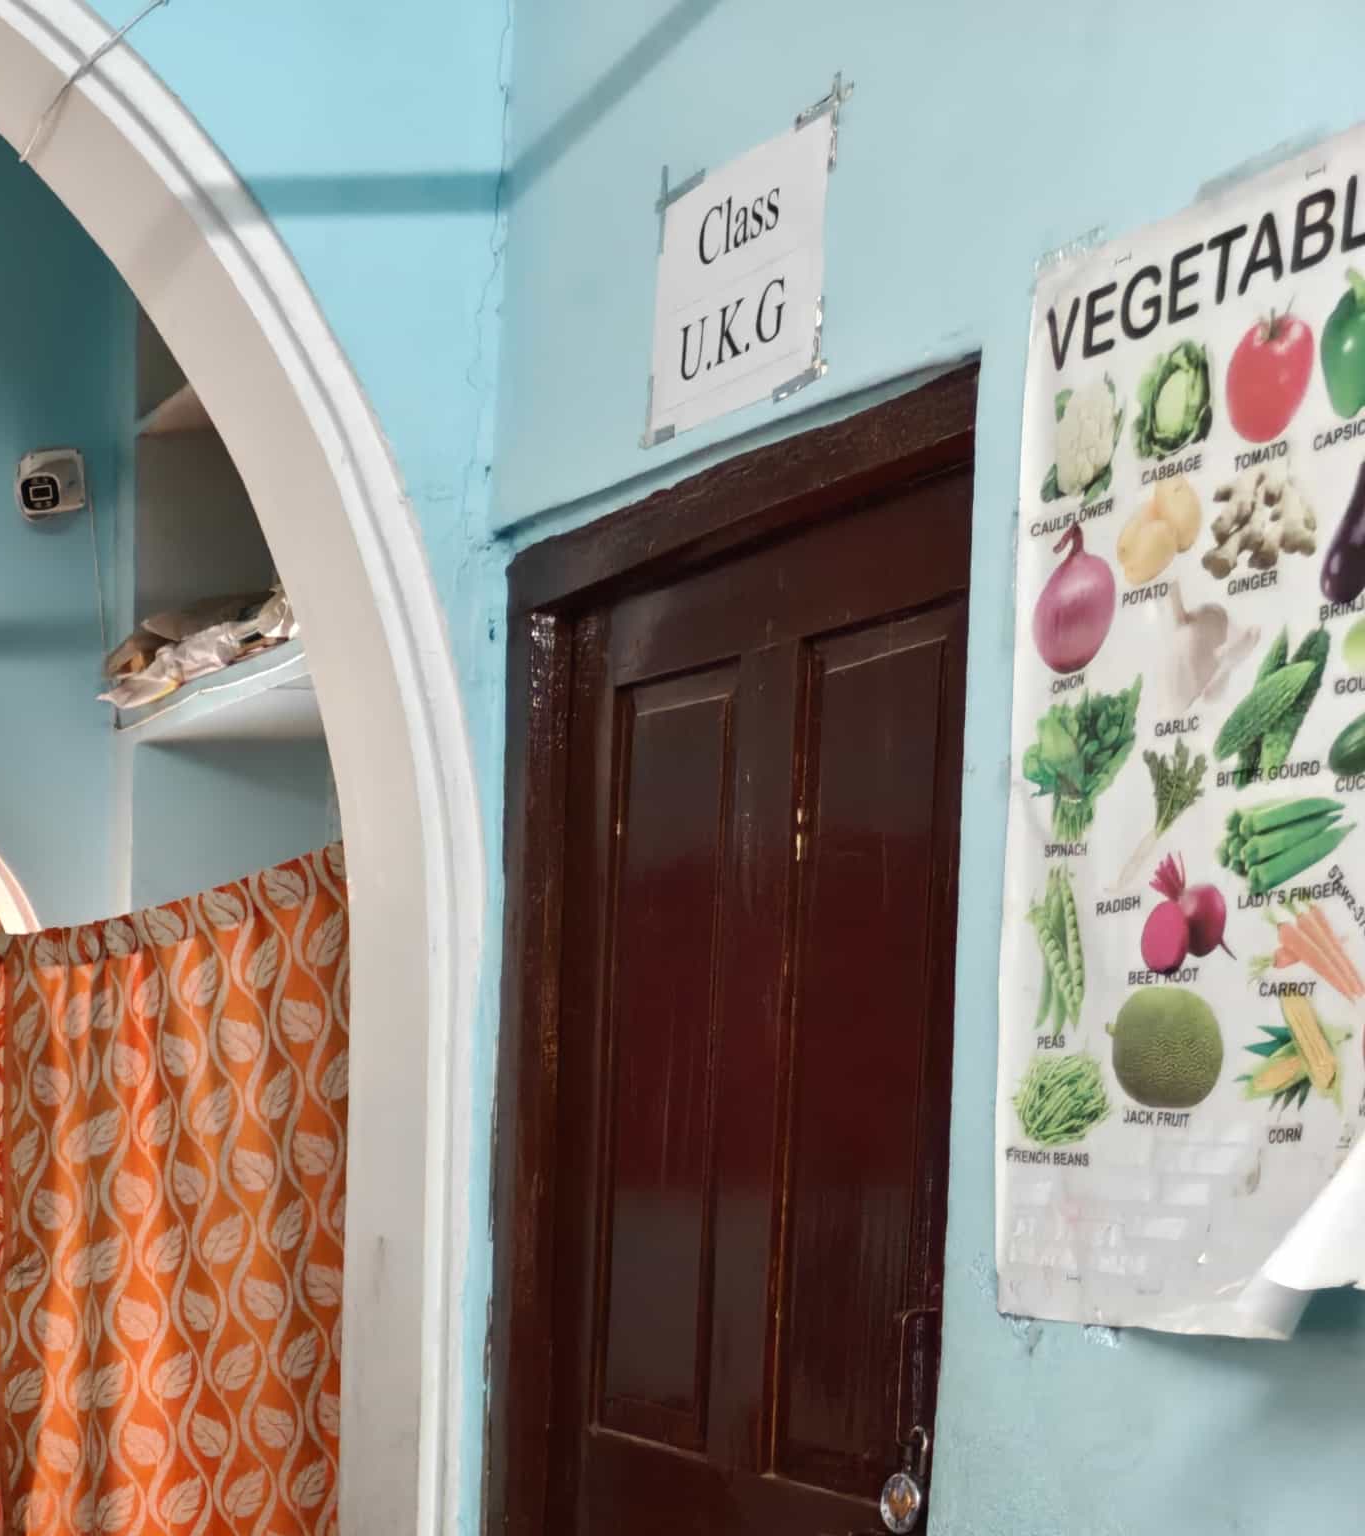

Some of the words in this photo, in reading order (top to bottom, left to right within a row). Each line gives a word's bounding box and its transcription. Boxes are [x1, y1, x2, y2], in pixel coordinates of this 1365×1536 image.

[699, 187, 780, 265] Class
[1046, 174, 1365, 371] VEGETABL
[680, 275, 785, 381] U.K.G
[1234, 440, 1288, 472] TOMATO
[1141, 454, 1202, 485] CABBAGE
[1030, 498, 1113, 537] CAULIFLOWER
[1227, 570, 1278, 595] GINGER
[1122, 582, 1168, 607] POTATO
[1052, 673, 1084, 695] ONION
[1155, 716, 1200, 737] GARLIC
[1268, 760, 1320, 780] GOURD
[1044, 843, 1087, 858] SPINACH
[1096, 896, 1141, 916] RADISH
[1237, 890, 1286, 910] LADY'S
[1290, 882, 1342, 902] FINGER
[1128, 971, 1159, 985] BEET
[1259, 981, 1316, 997] CARROT
[1037, 1035, 1065, 1049] PEAS
[1123, 1110, 1154, 1126] JACK
[1156, 1111, 1191, 1128] FRUIT
[1268, 1123, 1303, 1144] CORN
[1006, 1148, 1051, 1164] FRENCH
[1054, 1150, 1089, 1167] BEANS
